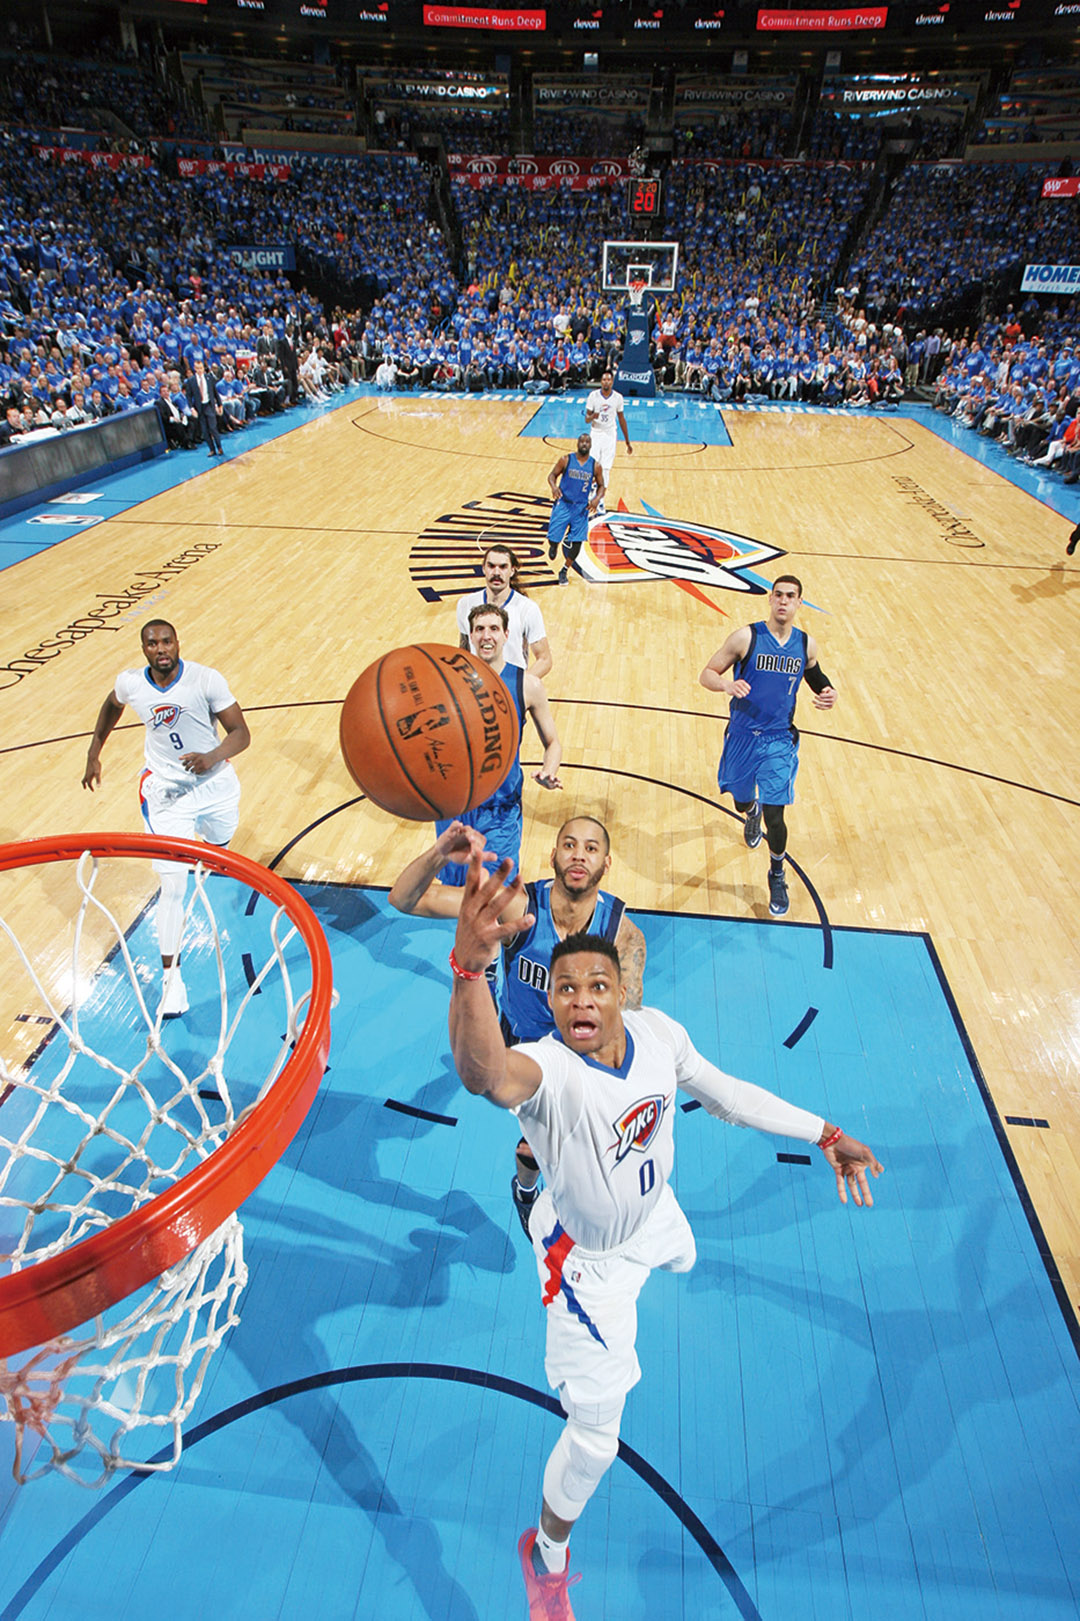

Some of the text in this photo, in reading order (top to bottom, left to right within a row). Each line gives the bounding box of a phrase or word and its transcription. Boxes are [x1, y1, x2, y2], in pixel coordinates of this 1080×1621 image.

[300, 5, 326, 18] devon
[360, 10, 387, 22] devon
[1054, 3, 1080, 16] devo
[427, 11, 542, 29] Commitment Runs Deep
[634, 19, 660, 29] devon
[694, 19, 721, 29] devon
[760, 14, 882, 28] Commitment Runs Deep
[447, 85, 487, 98] CASINO
[598, 89, 638, 100] CASINO
[684, 89, 785, 102] RIVERWIND CASINO
[843, 88, 952, 102] RIVERWIND CASINO
[634, 192, 655, 212] 20
[1025, 265, 1080, 283] HOME
[582, 482, 589, 493] 2
[134, 543, 223, 583] Arena
[755, 653, 802, 674] DALLAS
[787, 676, 797, 696] 7
[154, 708, 175, 725] OKC
[440, 653, 503, 774] SPALDING
[169, 732, 184, 750] 9
[518, 954, 550, 993] DA
[618, 1102, 655, 1160] OKC
[639, 1158, 656, 1197] 0
